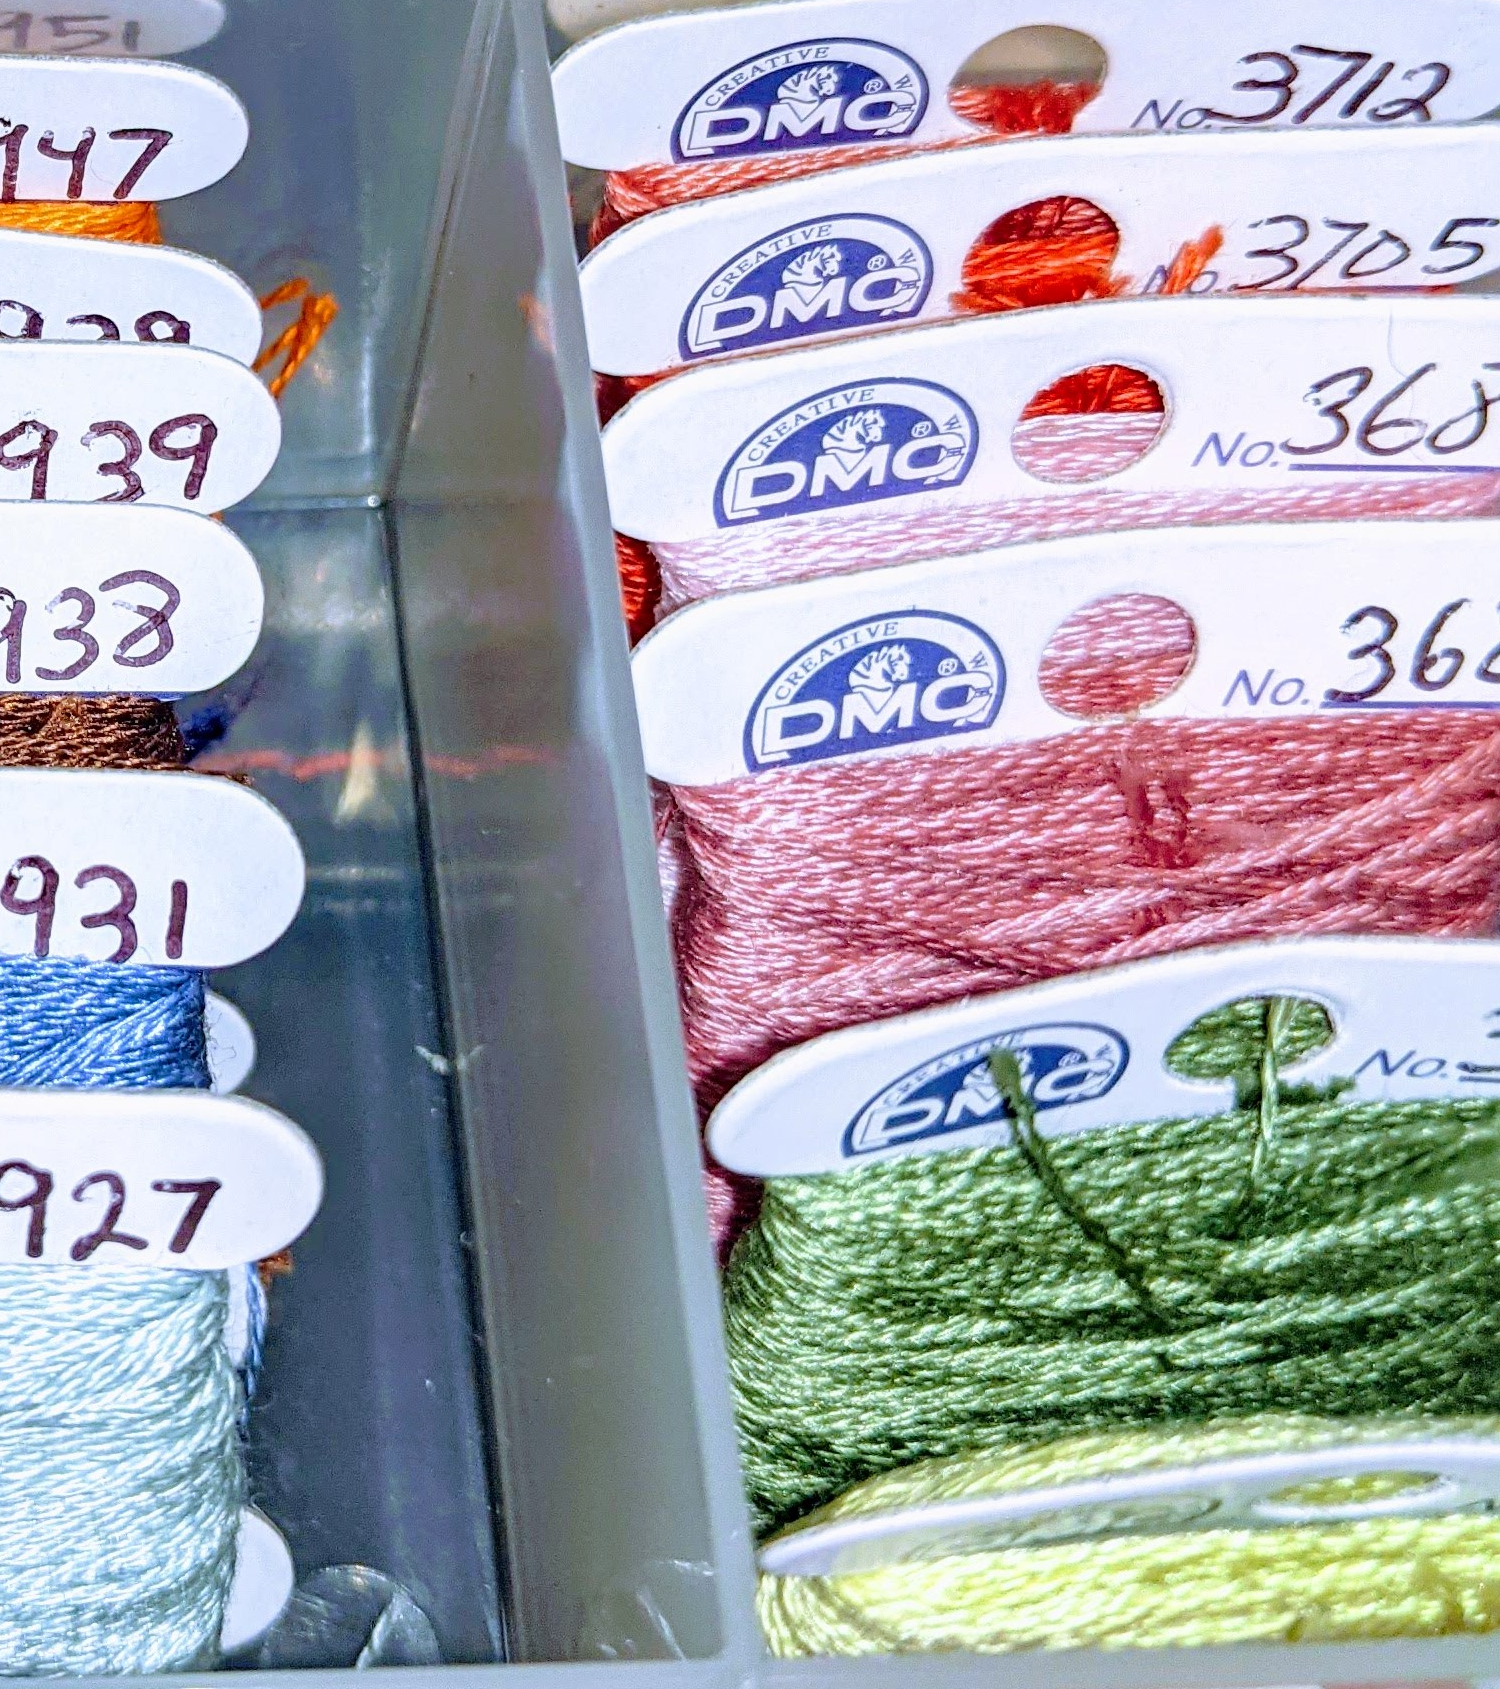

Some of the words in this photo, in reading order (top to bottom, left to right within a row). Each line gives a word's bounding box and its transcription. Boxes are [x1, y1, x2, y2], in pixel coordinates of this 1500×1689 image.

[705, 47, 830, 107] CREATIVE
[1203, 45, 1450, 124] 3712
[687, 90, 917, 150] DMC
[711, 224, 833, 298] CREATIVE
[1226, 215, 1500, 291] 3705
[695, 266, 921, 346] DMC
[748, 388, 876, 462] CREATIVE
[1191, 432, 1280, 467] No.
[731, 433, 967, 512] DMC
[775, 621, 900, 701] CREATIVE
[1222, 669, 1311, 707] No.
[761, 671, 994, 756] DMC
[0, 855, 188, 964] 931
[1353, 1048, 1448, 1078] No.
